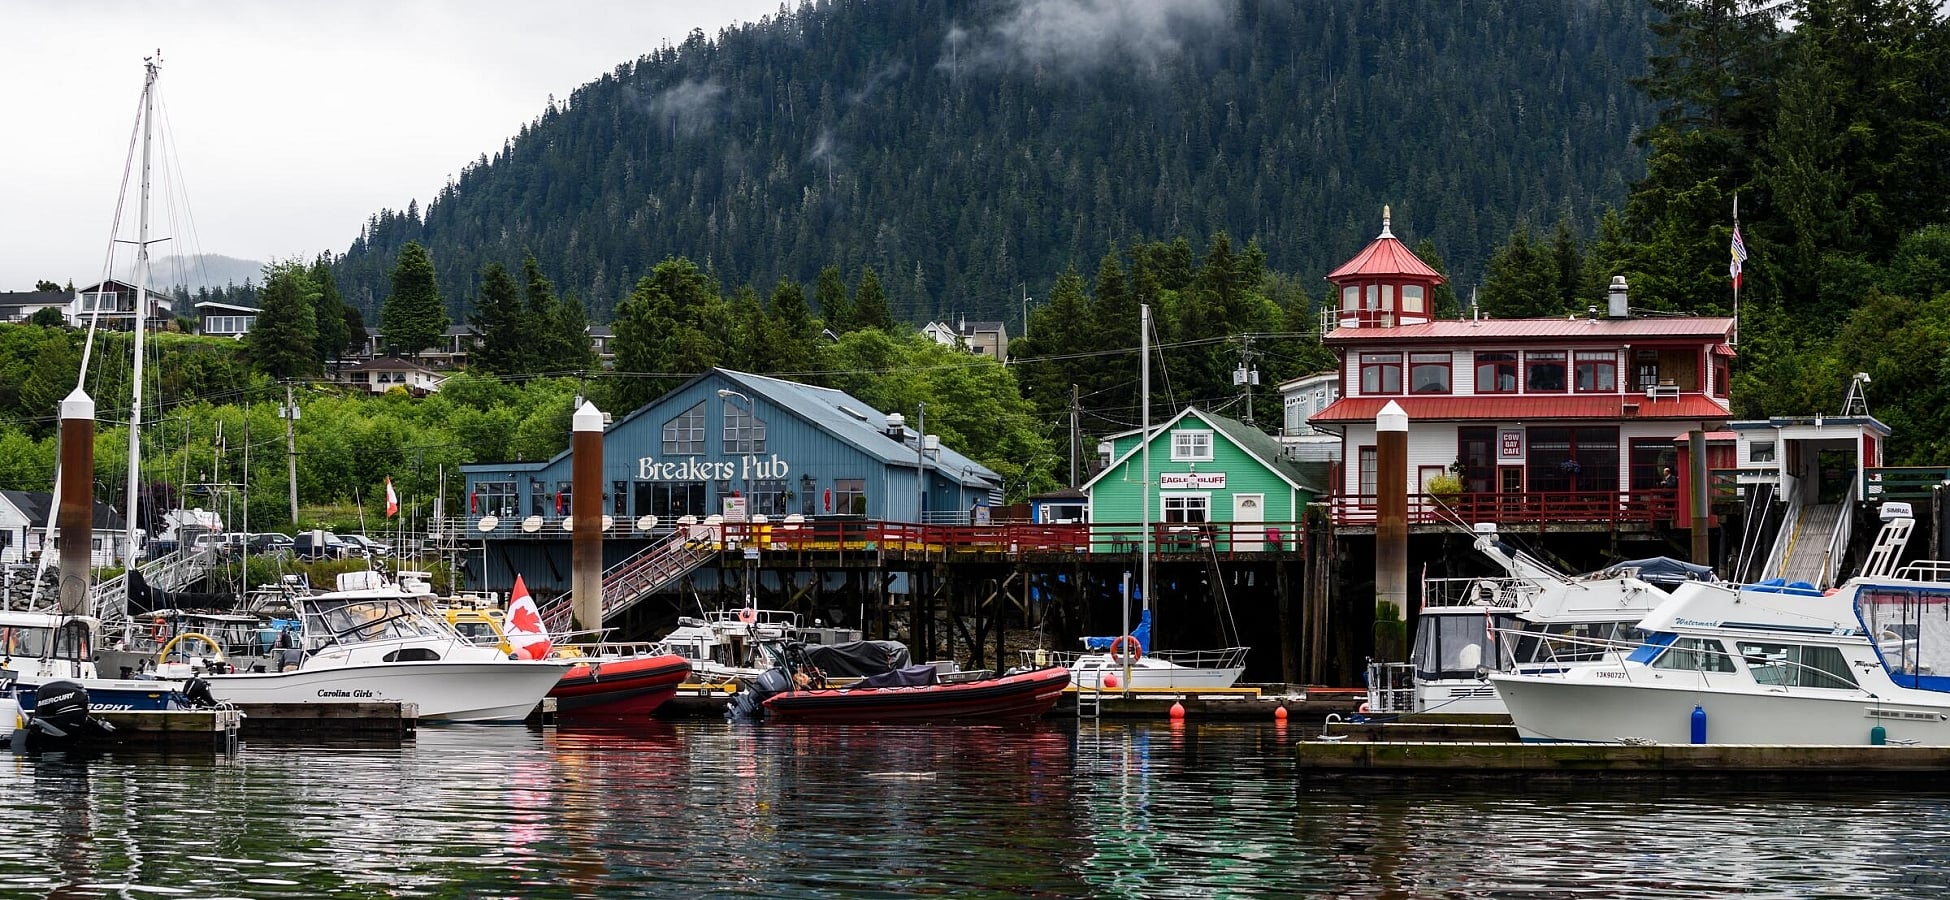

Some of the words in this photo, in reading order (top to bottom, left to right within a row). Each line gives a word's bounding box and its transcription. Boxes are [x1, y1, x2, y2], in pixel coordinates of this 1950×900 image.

[638, 456, 735, 481] Breakers
[742, 453, 789, 480] Pub
[1161, 476, 1189, 484] EAGLE
[1197, 476, 1225, 484] BLUFF
[1675, 617, 1718, 627] Watermark
[317, 689, 351, 698] Carolina
[353, 689, 373, 698] Girls
[37, 691, 76, 707] MERCURY
